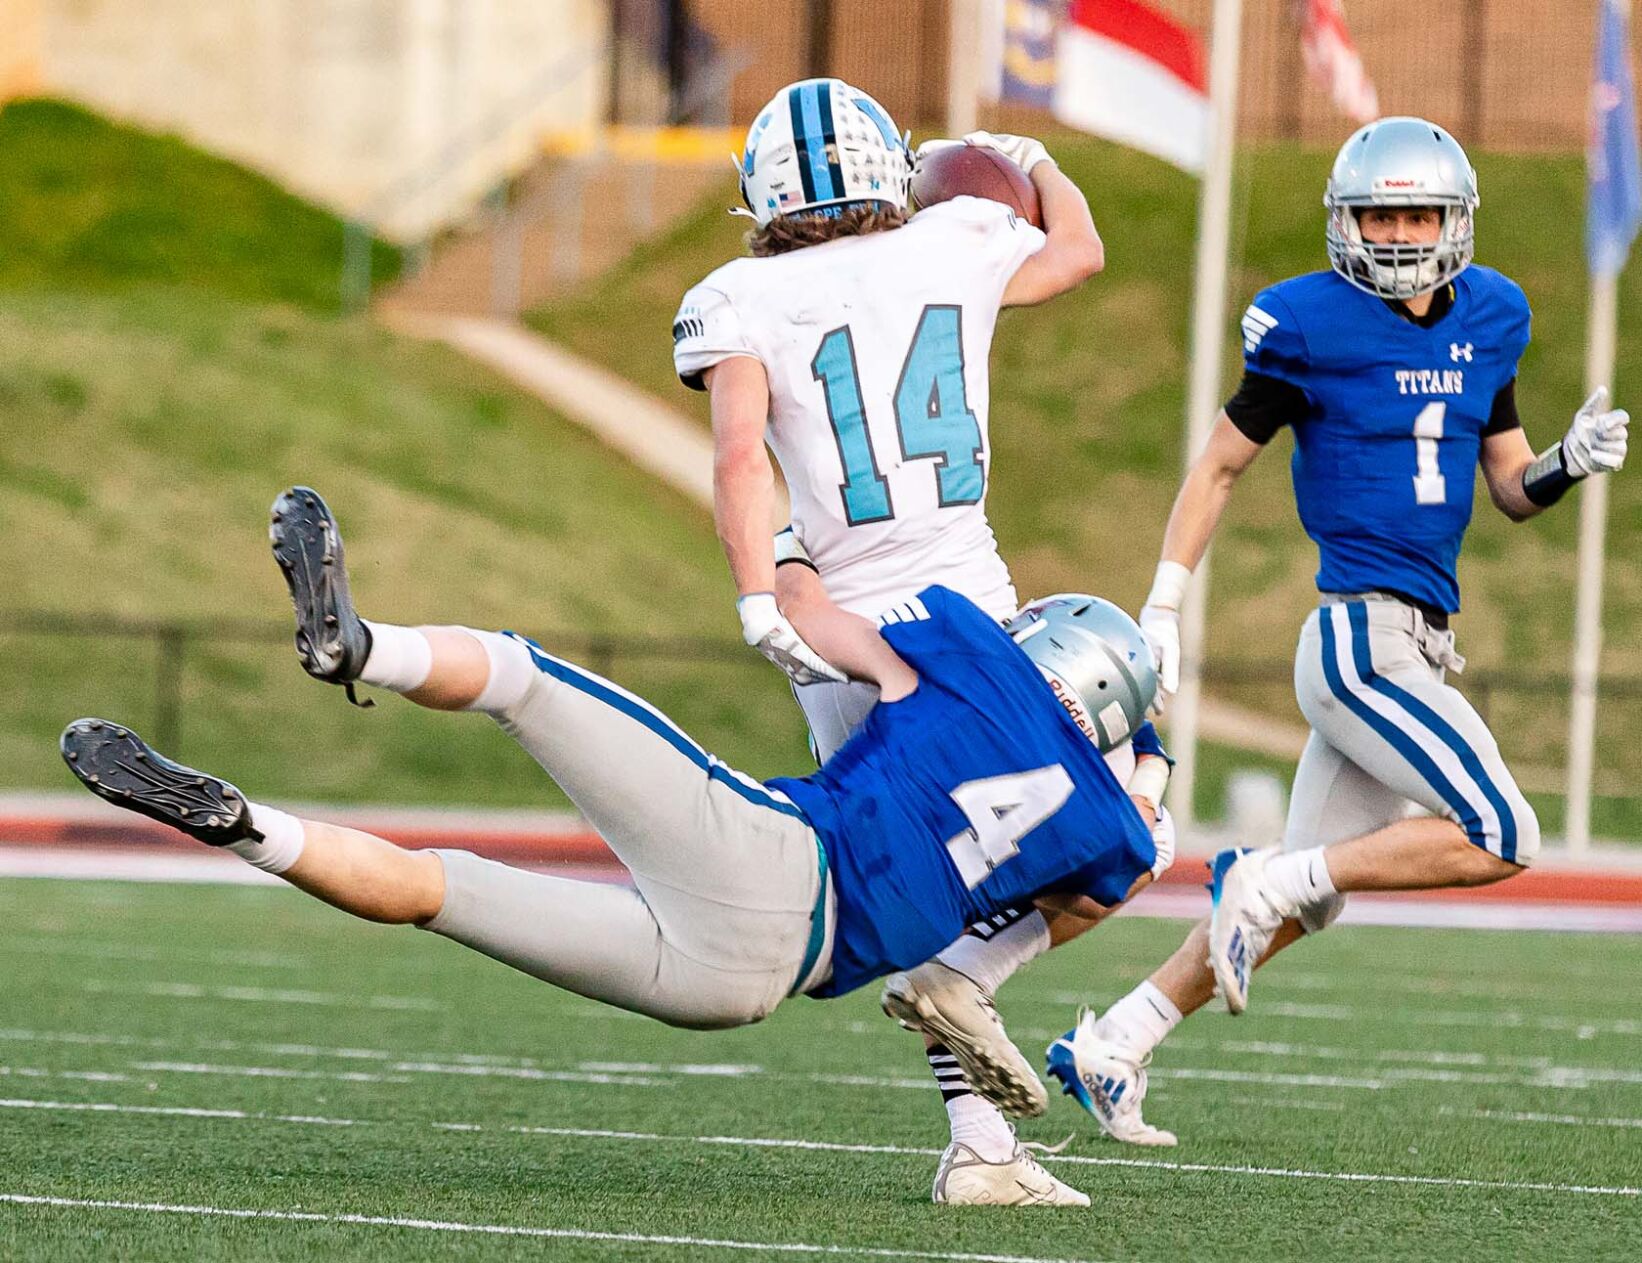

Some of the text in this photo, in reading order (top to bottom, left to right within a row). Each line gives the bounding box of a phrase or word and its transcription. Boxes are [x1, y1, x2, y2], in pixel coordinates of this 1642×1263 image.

[810, 304, 984, 527] 14
[1395, 369, 1463, 395] TITANS
[1412, 400, 1447, 505] 1
[945, 762, 1077, 892] 4
